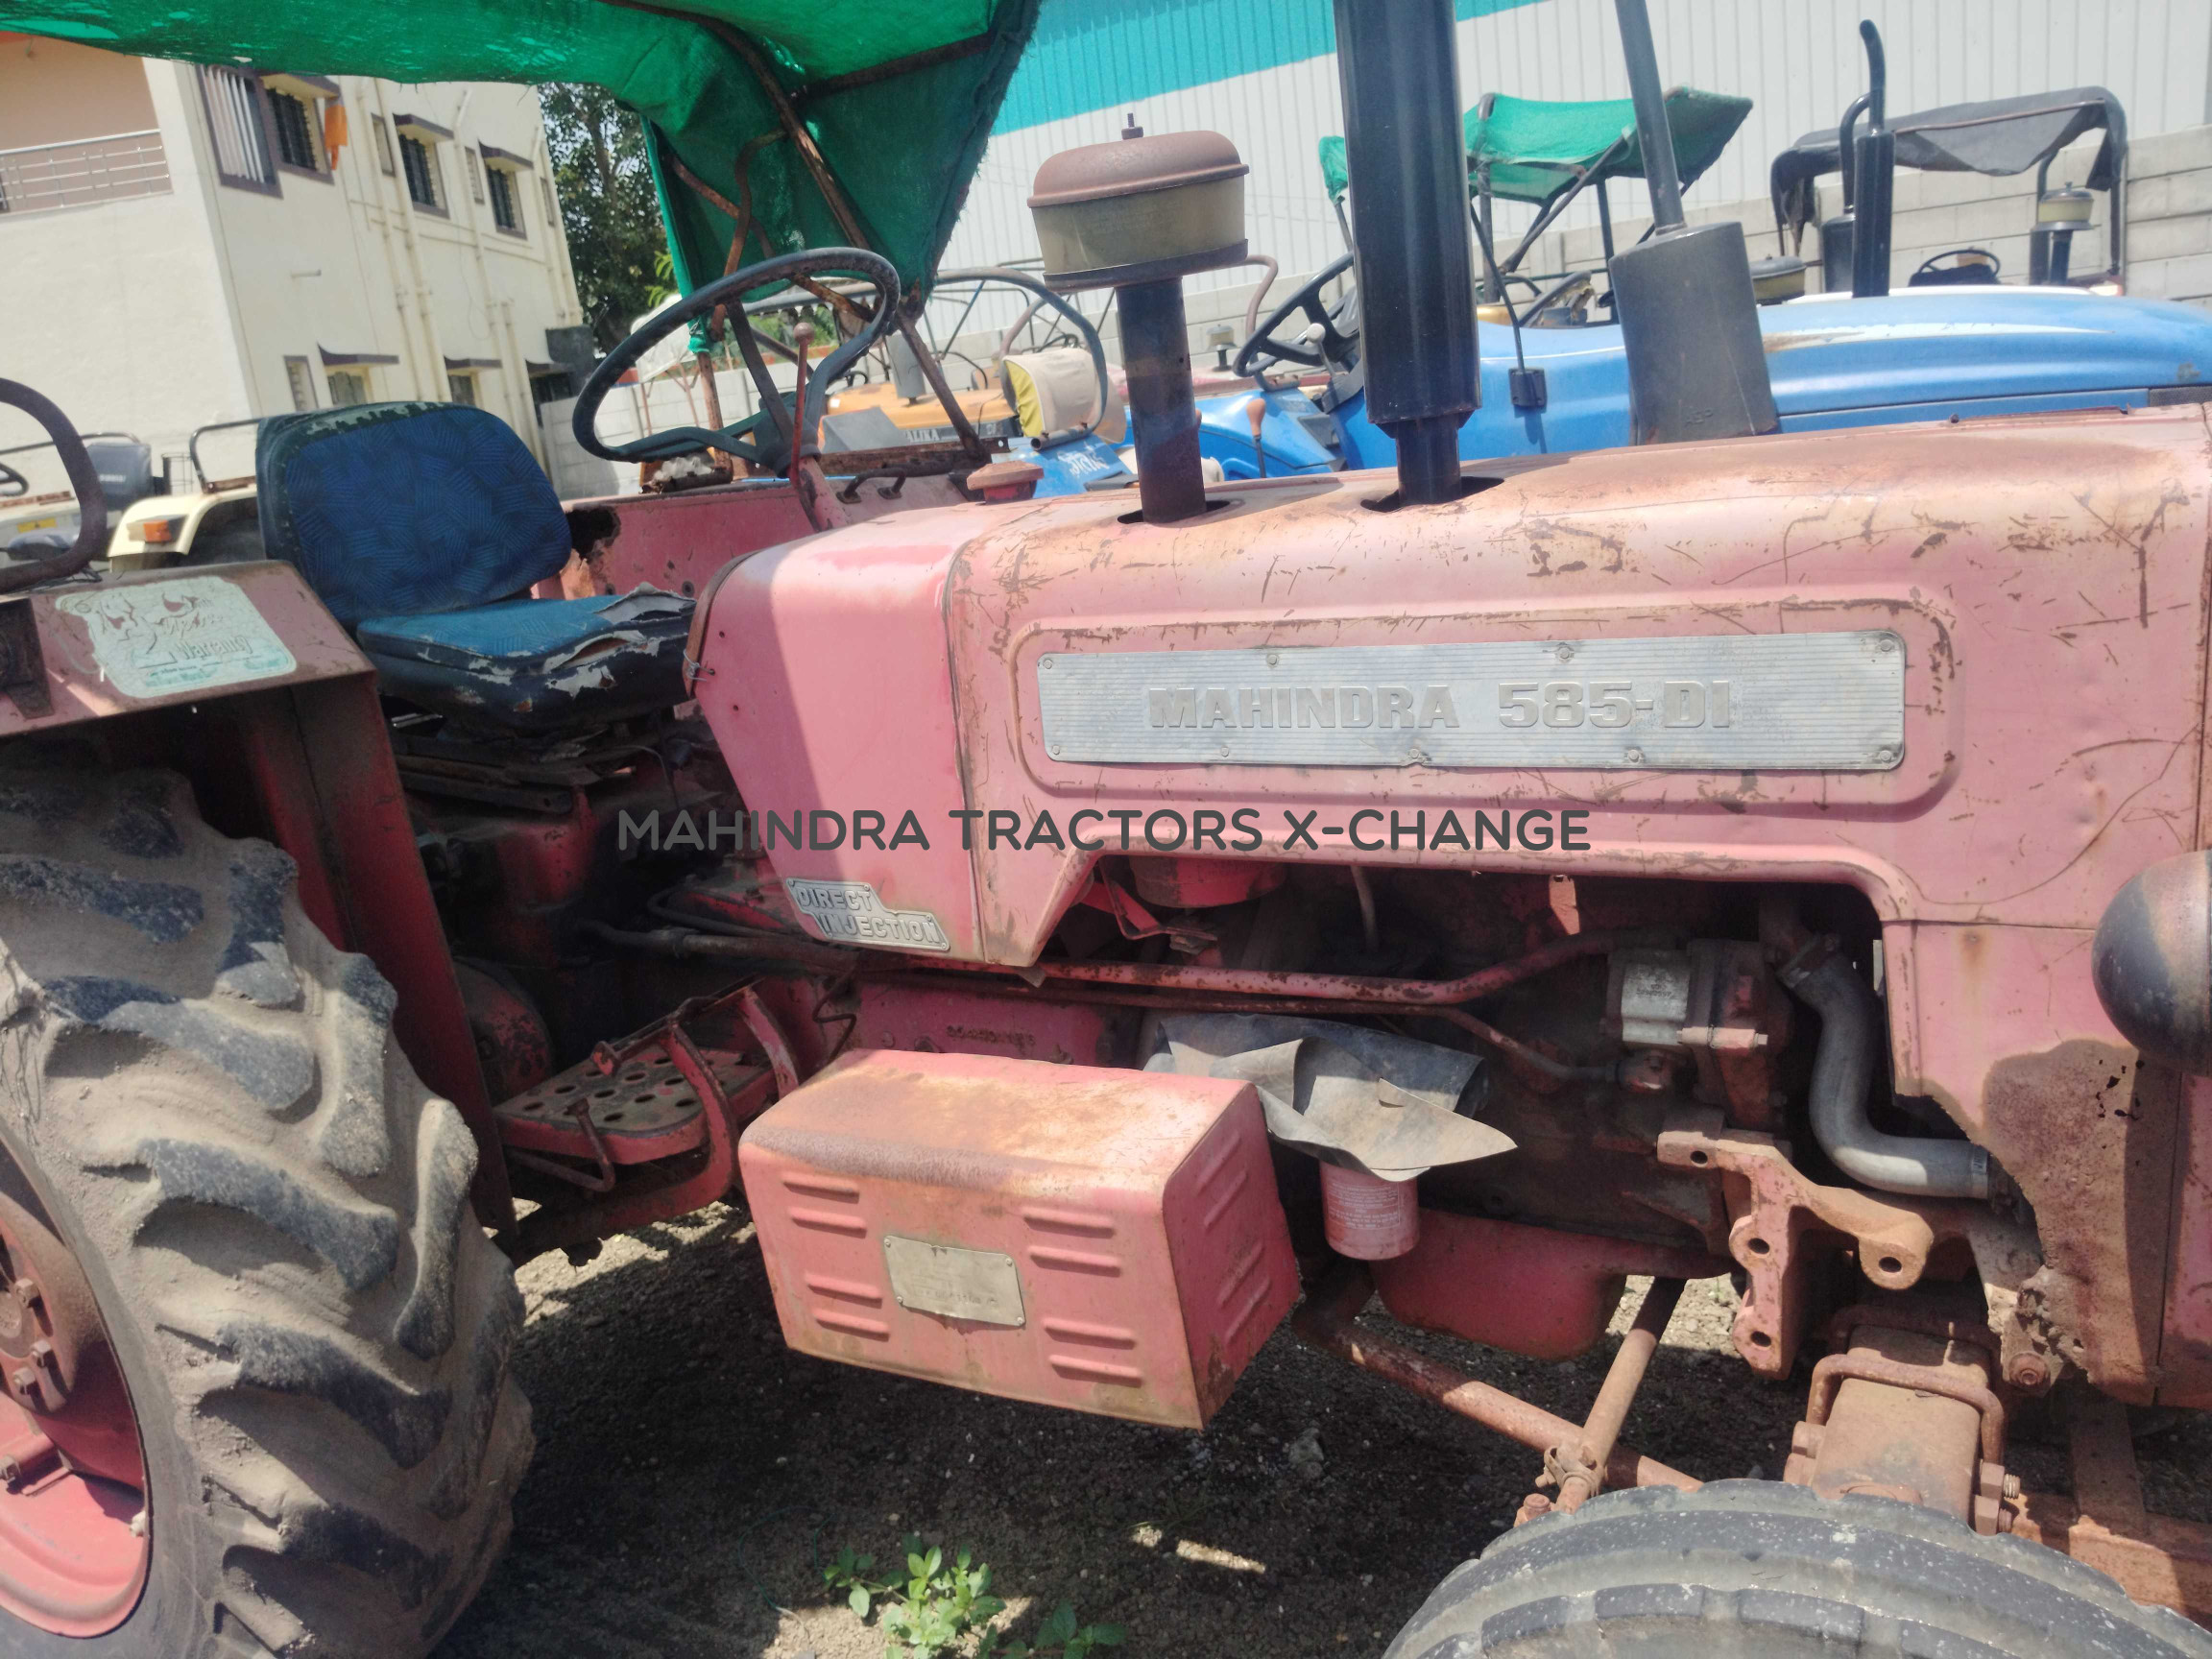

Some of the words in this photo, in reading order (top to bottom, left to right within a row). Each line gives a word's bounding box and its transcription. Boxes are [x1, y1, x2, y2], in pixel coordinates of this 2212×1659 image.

[1149, 685, 1459, 729] MAHINDRA
[795, 886, 872, 912] DIRECT
[819, 913, 940, 943] INJECTION
